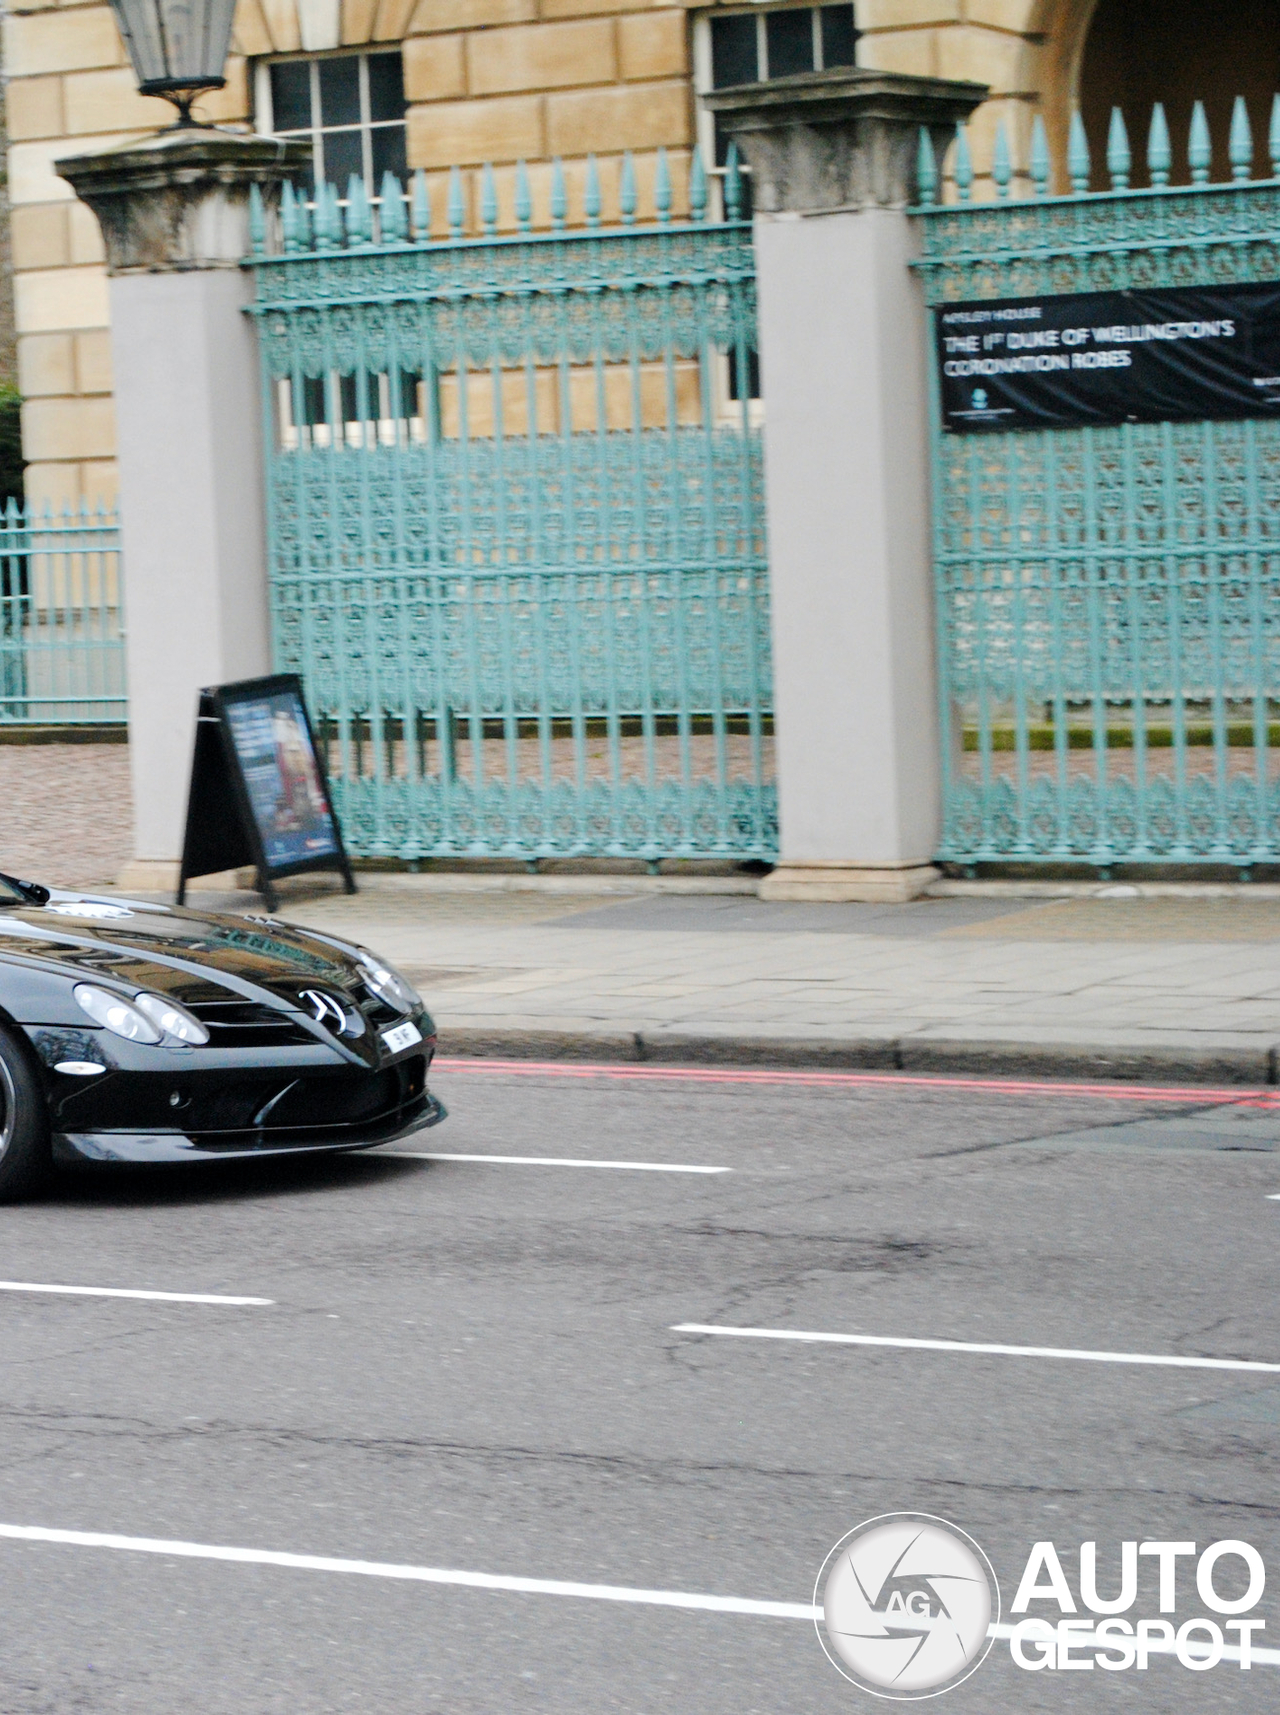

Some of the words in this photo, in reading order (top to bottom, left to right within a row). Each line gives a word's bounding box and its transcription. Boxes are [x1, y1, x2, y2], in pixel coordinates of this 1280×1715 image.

[992, 306, 1042, 321] HOUSE
[942, 335, 980, 353] THE
[1006, 329, 1060, 349] DUKE
[1061, 327, 1091, 346] OF
[1091, 319, 1236, 343] WELLINGTON'S
[943, 354, 1069, 377] CORONATION
[1071, 349, 1132, 369] ROBES
